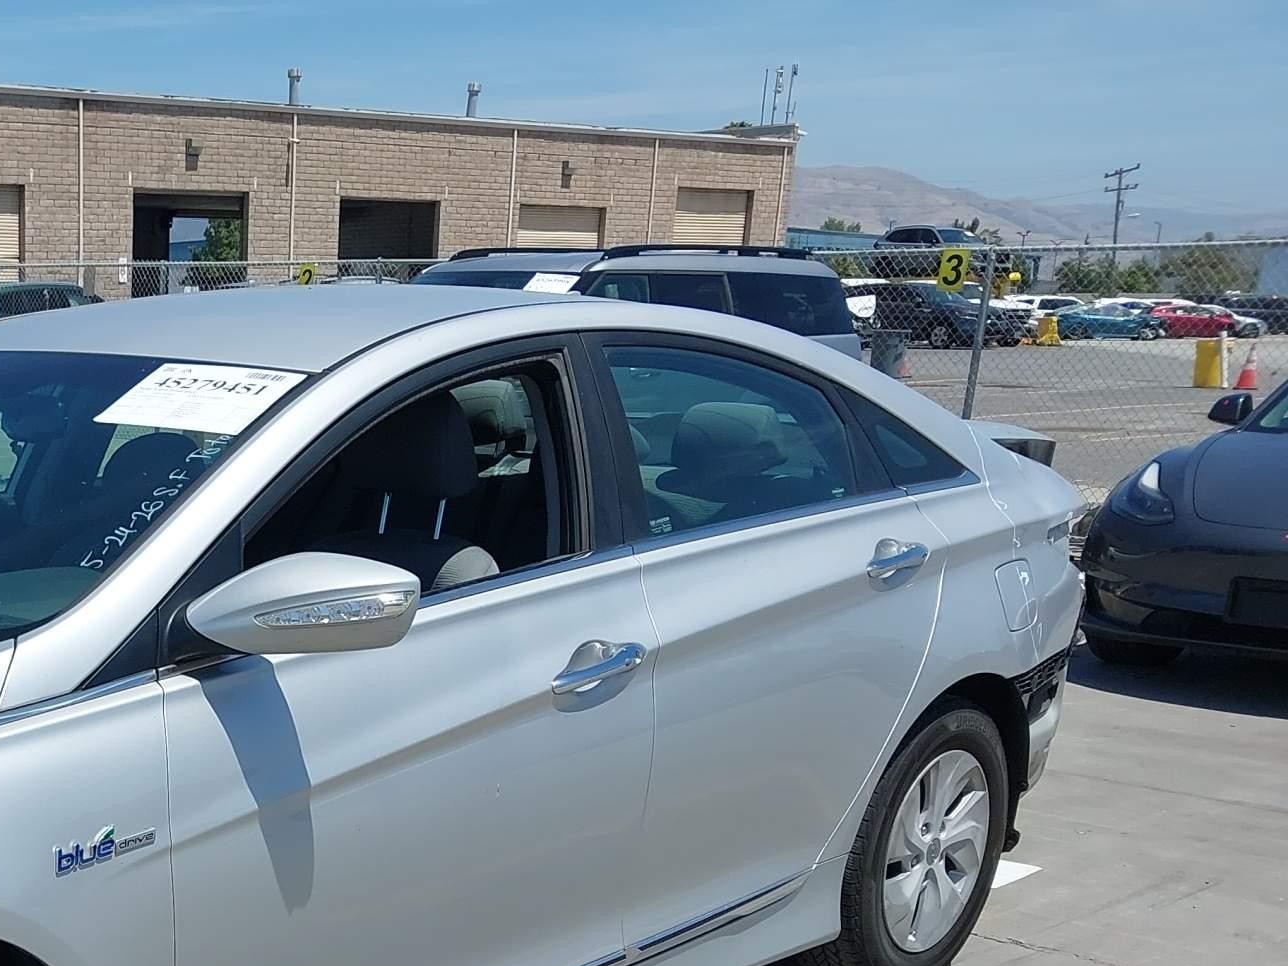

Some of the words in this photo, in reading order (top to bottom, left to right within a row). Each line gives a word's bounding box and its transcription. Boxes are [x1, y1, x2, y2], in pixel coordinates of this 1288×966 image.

[942, 253, 964, 286] 3
[154, 376, 270, 396] 45279451
[53, 834, 116, 878] blue
[117, 832, 156, 851] drive
